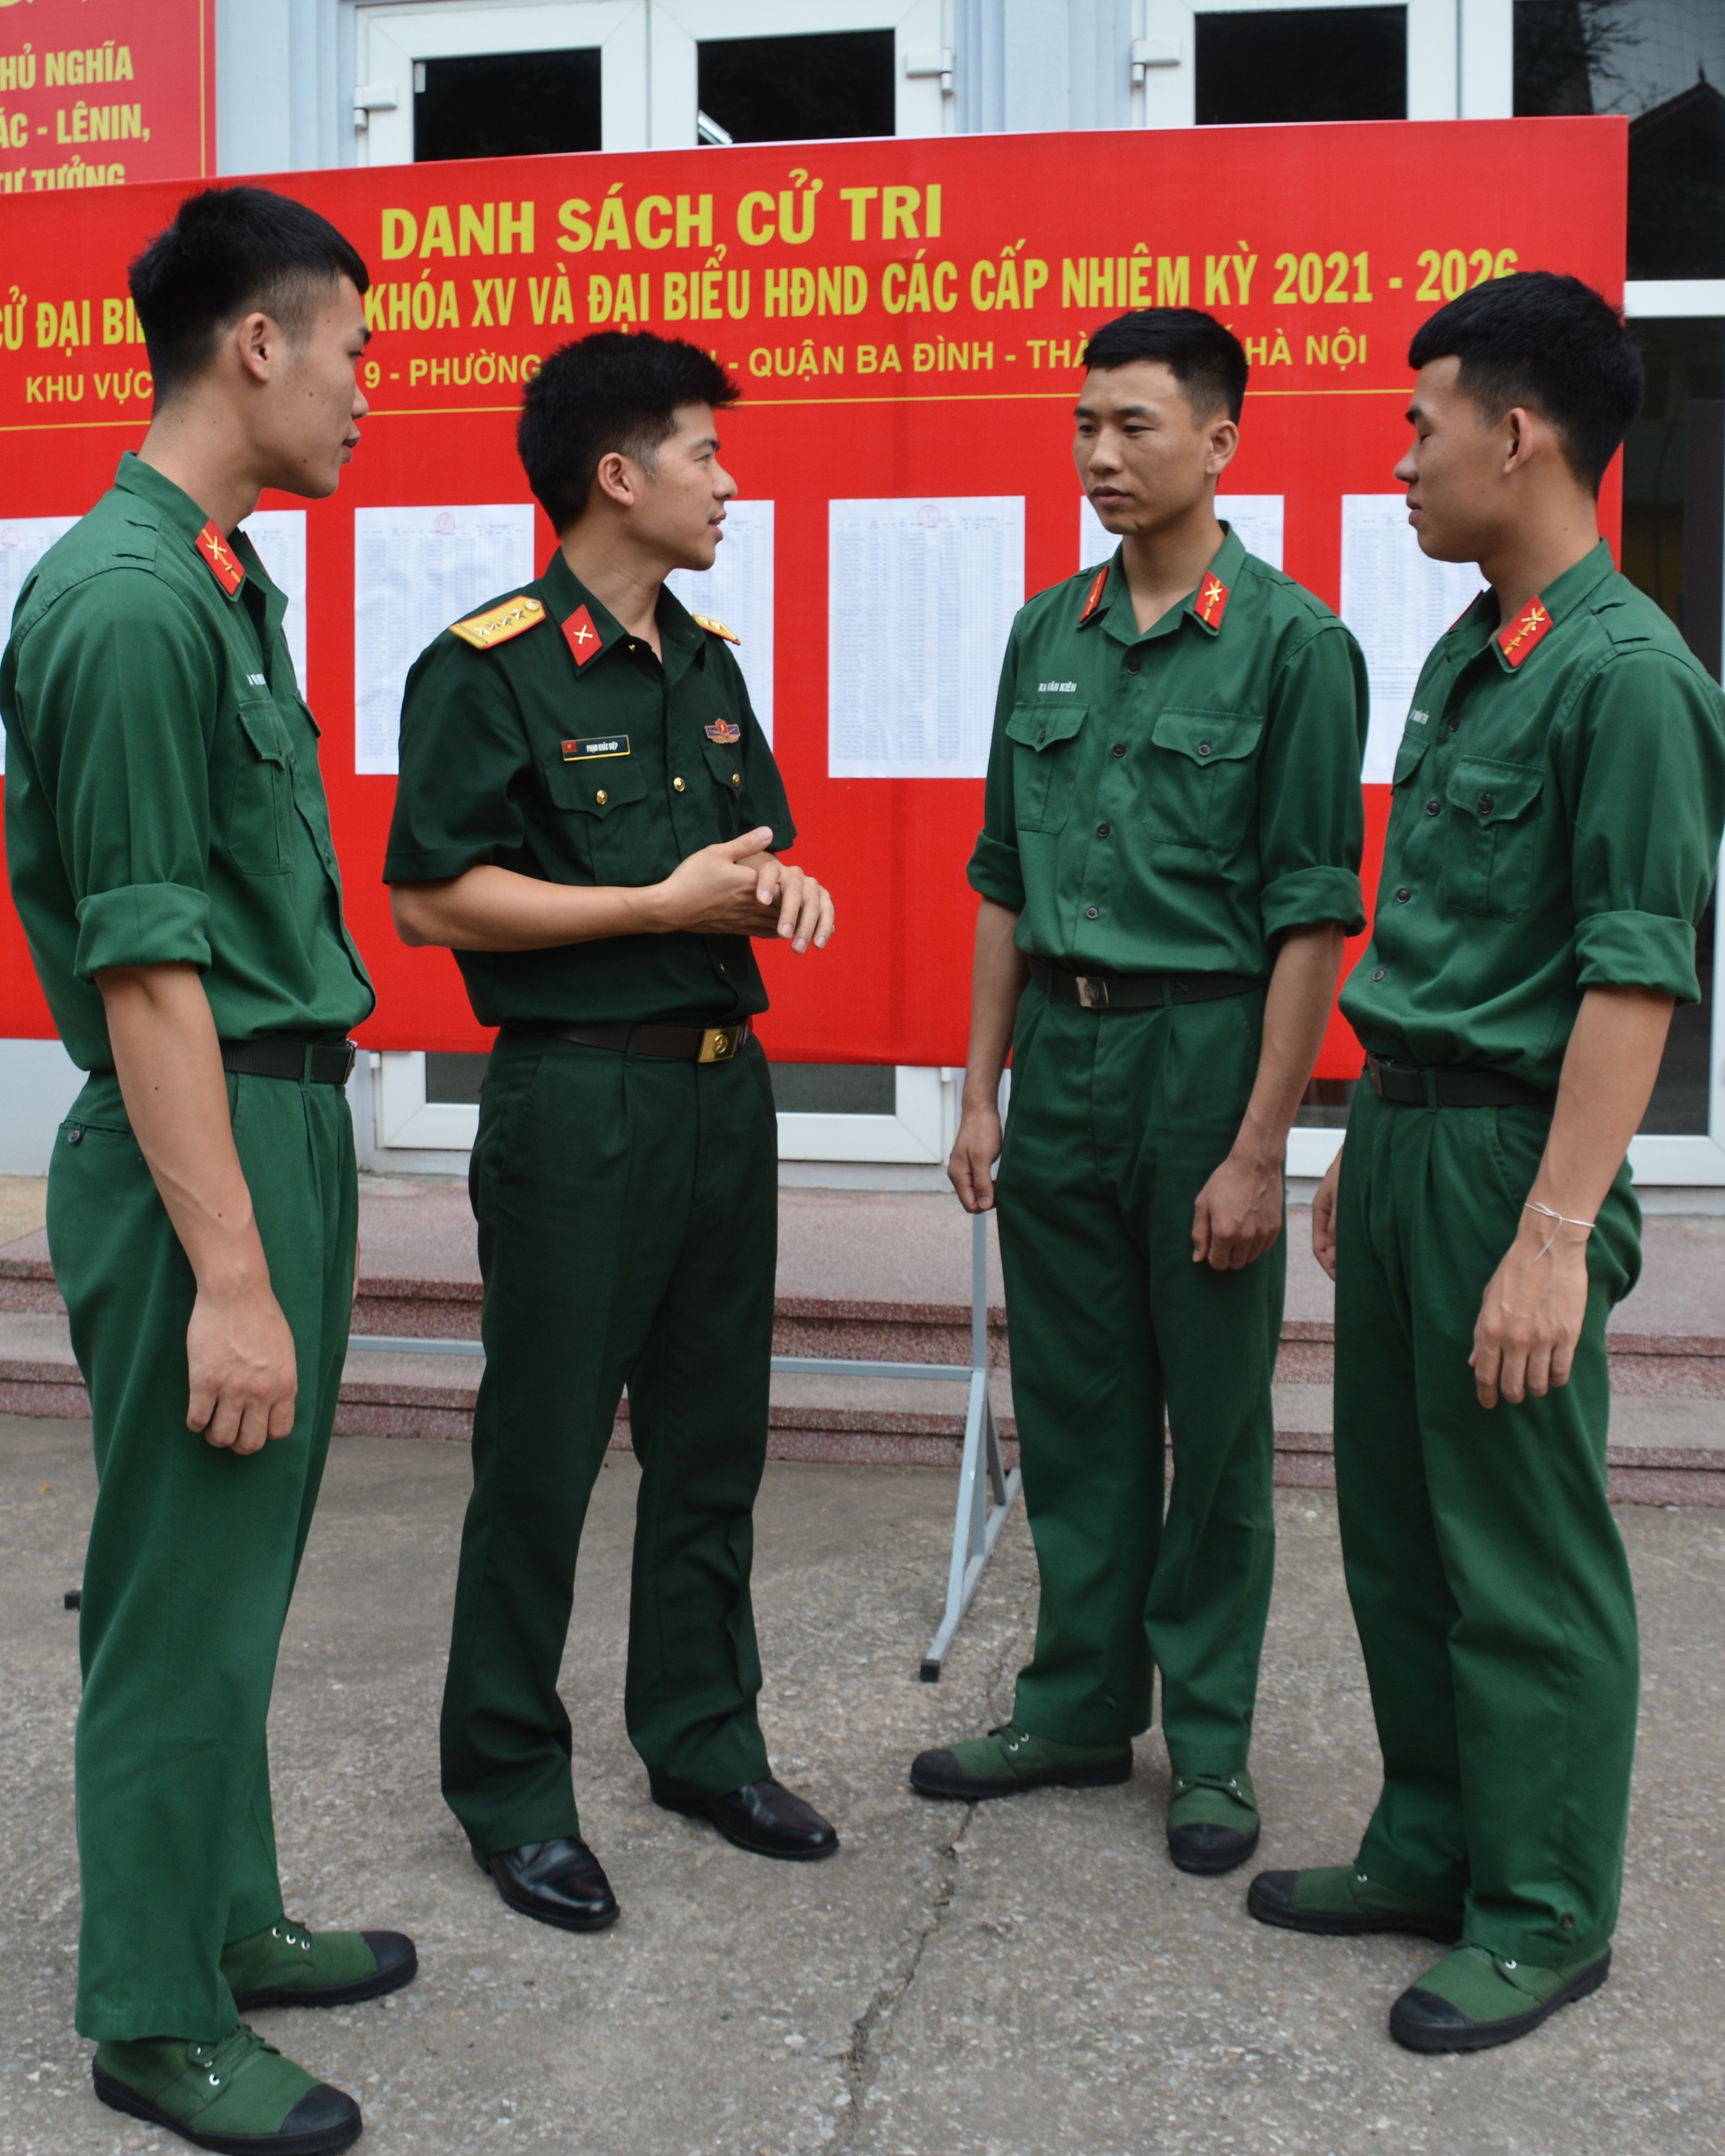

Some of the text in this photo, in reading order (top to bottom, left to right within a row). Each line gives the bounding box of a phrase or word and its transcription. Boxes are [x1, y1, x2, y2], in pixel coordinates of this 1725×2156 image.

[45, 40, 134, 87] NGHĨA
[57, 101, 150, 144] LÊNIN,
[382, 169, 941, 260] DANH SÁCH CỬ TRI
[0, 286, 27, 350] Ử
[37, 300, 90, 356] ĐẠI
[364, 269, 459, 331] KHÓA
[472, 278, 516, 326] XV
[529, 263, 574, 324] VÀ
[588, 274, 649, 332] ĐẠI
[664, 243, 750, 320] BIỂU
[765, 266, 868, 317] HĐND
[882, 249, 957, 314] CÁC
[971, 239, 1048, 311] CẤP
[1063, 243, 1190, 312] NHIỆM
[1206, 240, 1257, 305] KỲ
[1274, 252, 1372, 304] 2021
[1416, 248, 1518, 301] 2026
[27, 375, 83, 402] KHU
[93, 367, 153, 405] VỰC
[365, 362, 380, 388] 9
[411, 350, 541, 386] PHƯỜNG
[750, 339, 843, 381] QUẬN
[857, 344, 901, 373] BA
[913, 335, 994, 372] ĐÌNH
[1246, 328, 1292, 365] HÀ
[1306, 327, 1366, 370] NỘI
